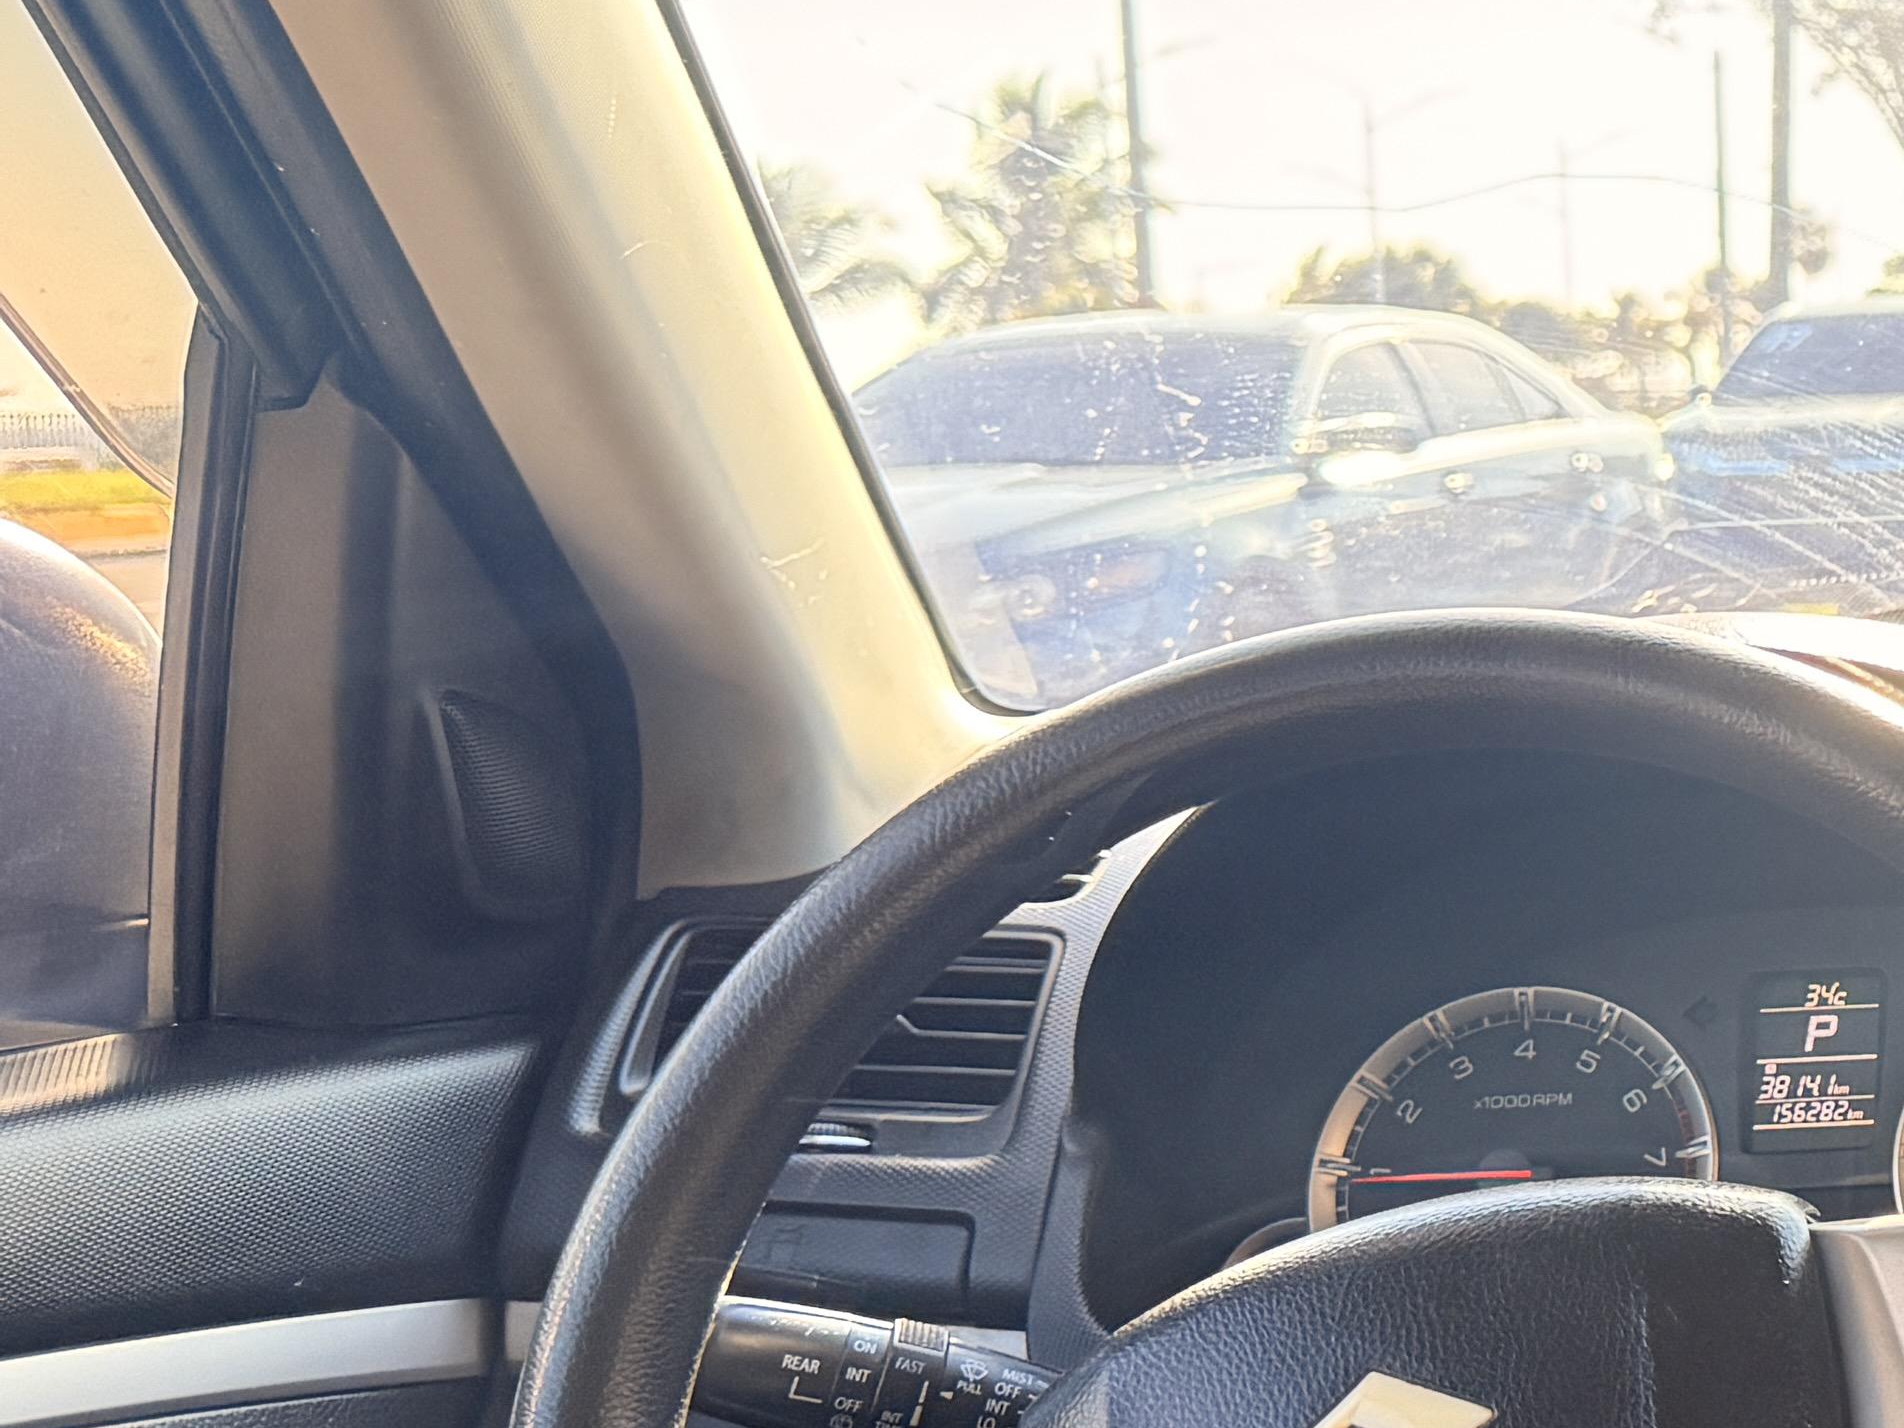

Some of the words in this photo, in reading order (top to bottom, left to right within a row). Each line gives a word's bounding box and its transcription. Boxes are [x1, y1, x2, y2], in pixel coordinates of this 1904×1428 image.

[1804, 1015, 1839, 1052] P
[1513, 1039, 1537, 1059] 4
[1449, 1055, 1474, 1080] 3
[1576, 1049, 1601, 1074] 5
[1622, 1088, 1647, 1113] 6
[1397, 1099, 1423, 1124] 2
[1644, 1147, 1668, 1169] 7
[853, 1340, 878, 1354] ON
[782, 1354, 821, 1375] REAR
[895, 1357, 927, 1374] FAST
[845, 1367, 872, 1383] INT
[1002, 1368, 1035, 1385] MIST
[994, 1382, 1022, 1399] OFF
[834, 1397, 863, 1412] OFF
[985, 1398, 1011, 1415] INT
